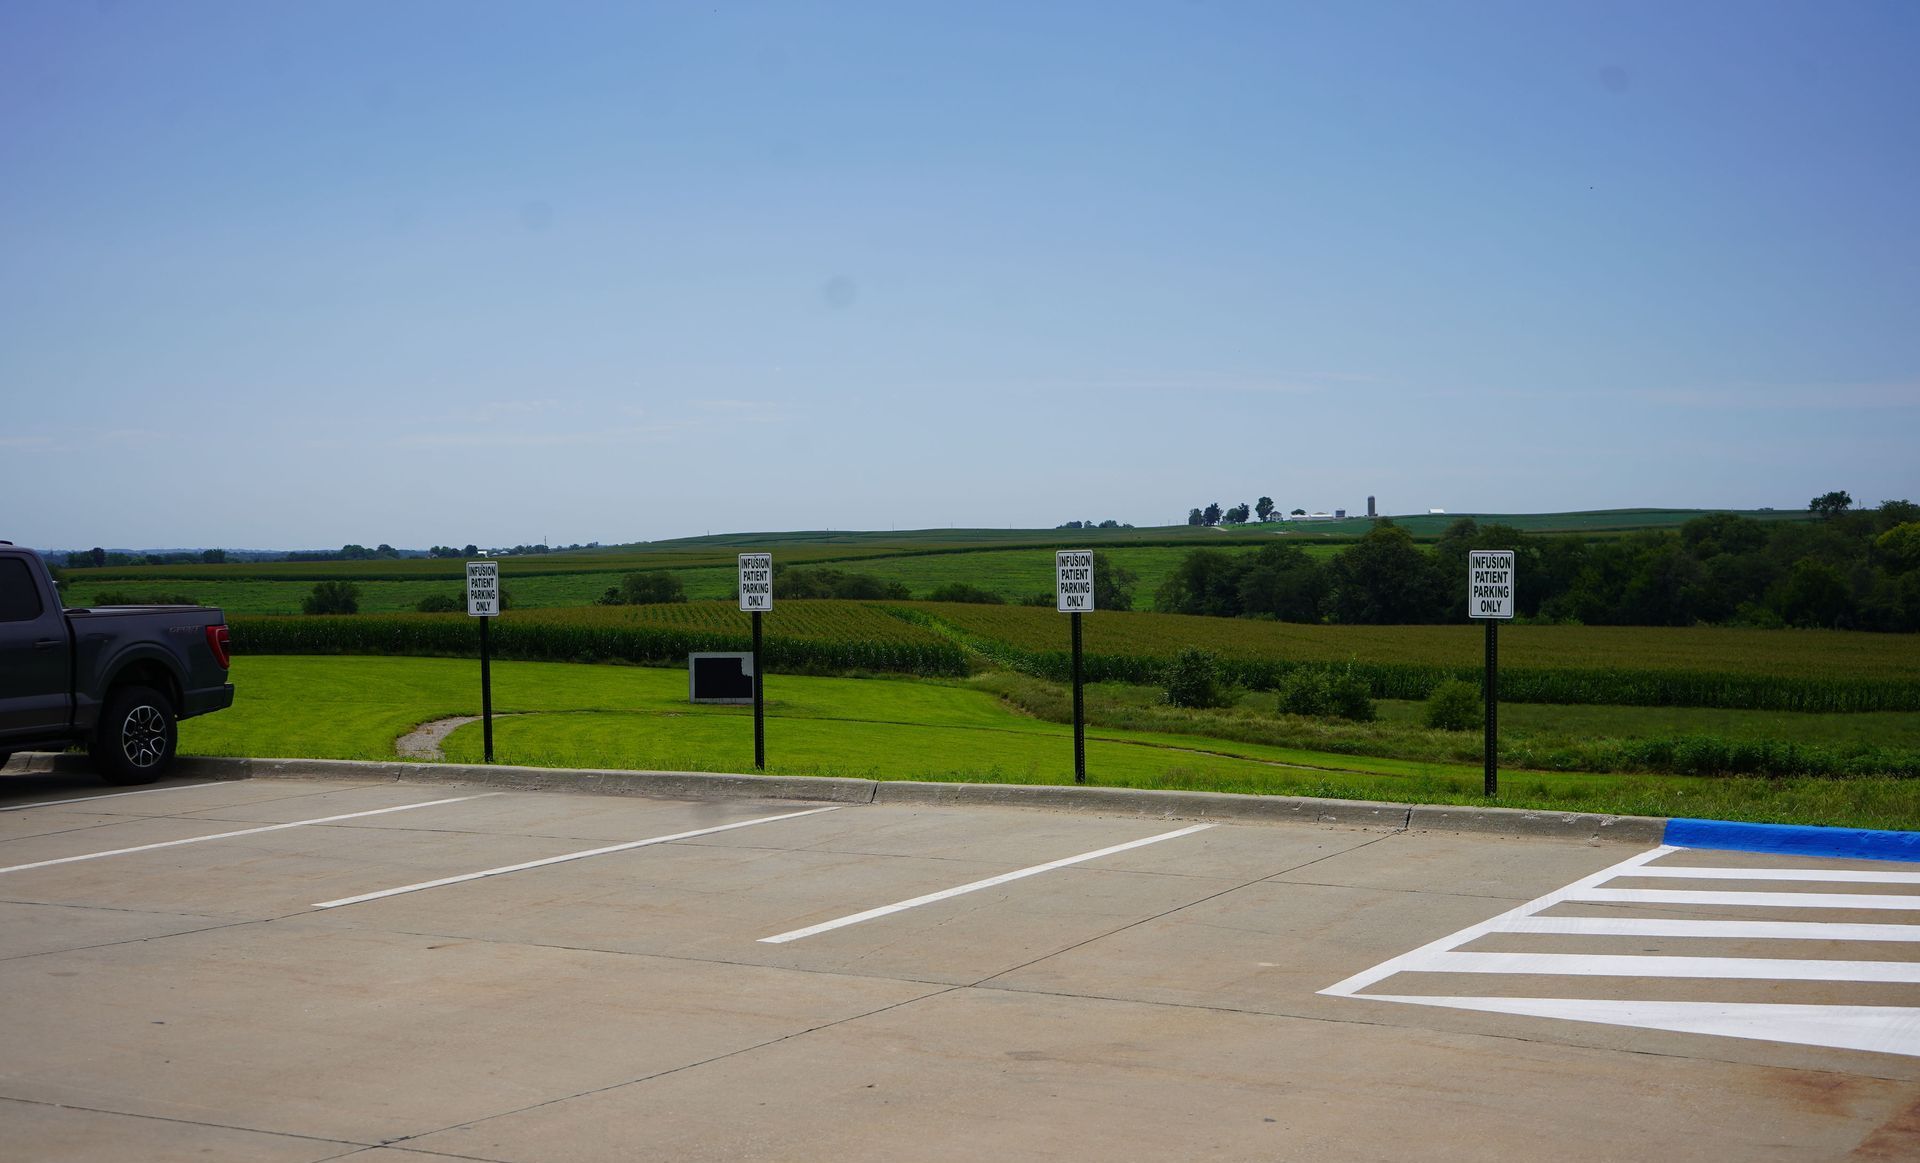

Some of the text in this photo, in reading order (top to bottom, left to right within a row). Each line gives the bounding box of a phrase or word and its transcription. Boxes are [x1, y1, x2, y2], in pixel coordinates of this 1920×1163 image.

[742, 558, 769, 568] INFUSION
[1060, 556, 1090, 566] INFUSION
[1473, 556, 1510, 568] INFUSION
[744, 571, 767, 581] PATIENT
[1062, 569, 1088, 580] PATIENT
[1476, 571, 1508, 583] PATIENT
[743, 583, 768, 593] PARKING
[1061, 582, 1090, 593] PARKING
[1474, 586, 1509, 598] PARKING
[748, 596, 763, 606] ONLY
[1067, 596, 1084, 607] ONLY
[1481, 600, 1501, 612] ONLY
